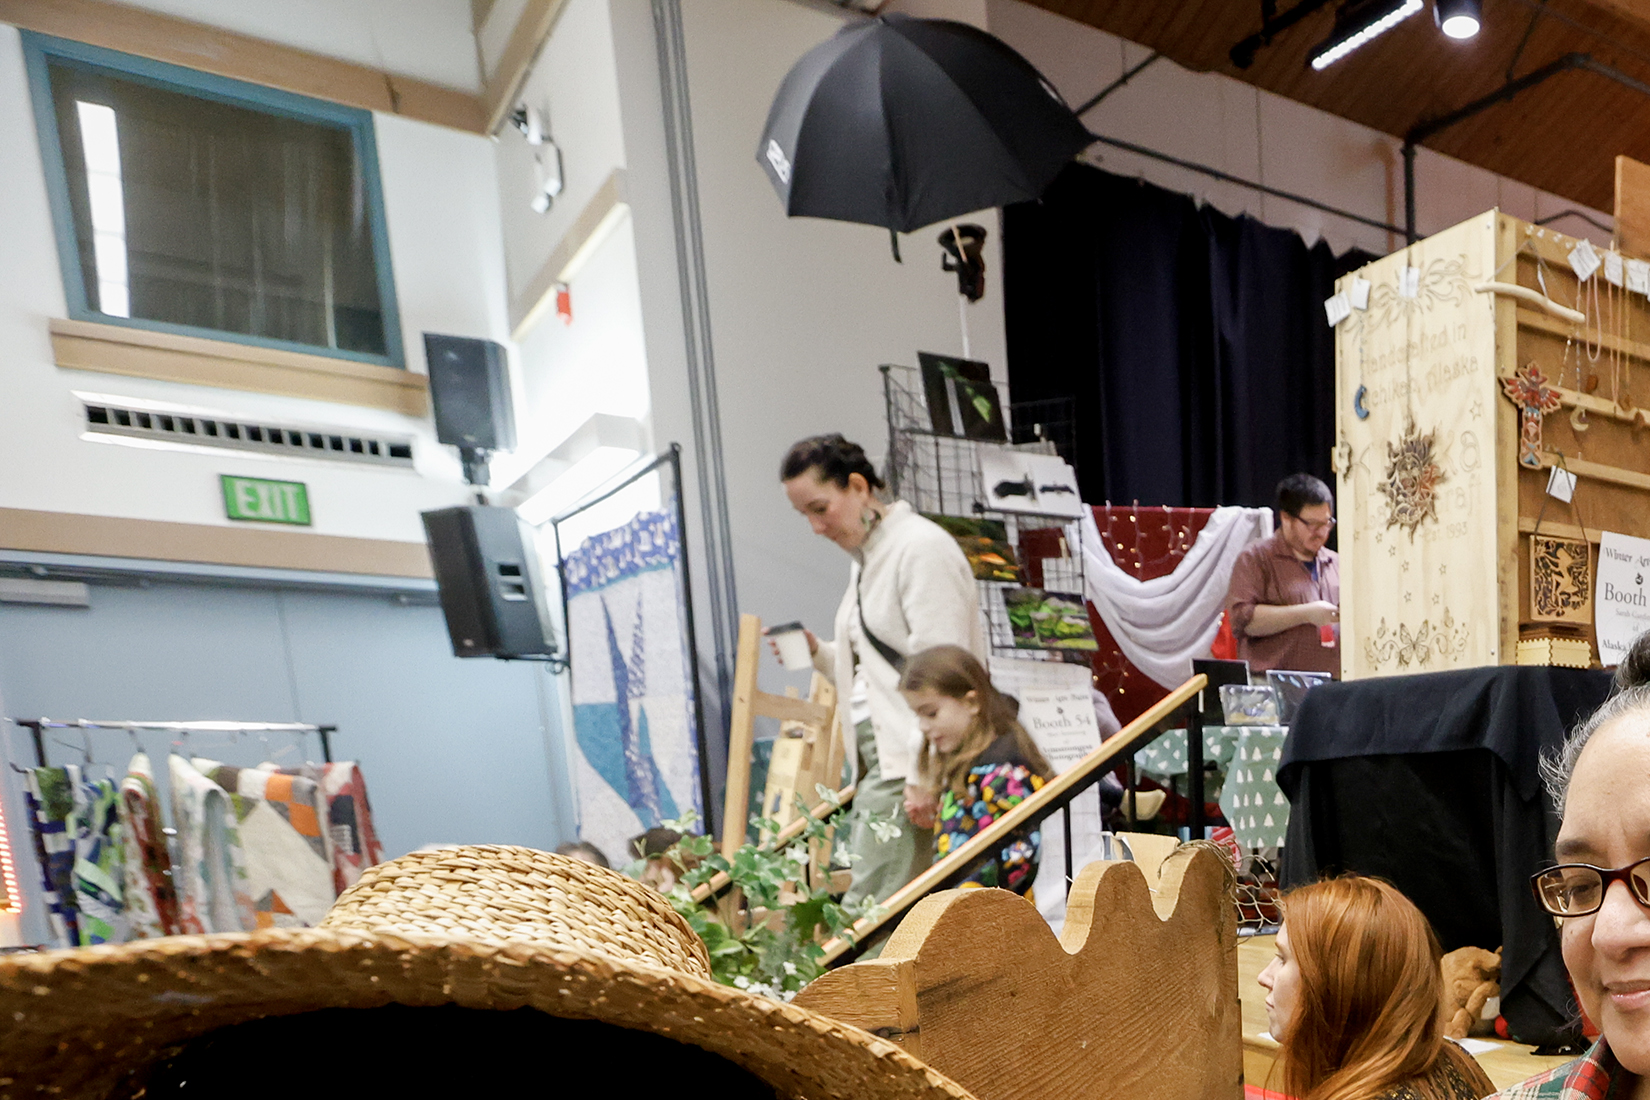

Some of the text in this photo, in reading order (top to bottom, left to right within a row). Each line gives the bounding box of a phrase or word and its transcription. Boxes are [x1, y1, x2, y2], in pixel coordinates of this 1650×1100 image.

[235, 479, 299, 519] EXIT
[1604, 547, 1633, 563] Winter
[1604, 581, 1647, 607] Booth
[1032, 715, 1072, 729] Booth
